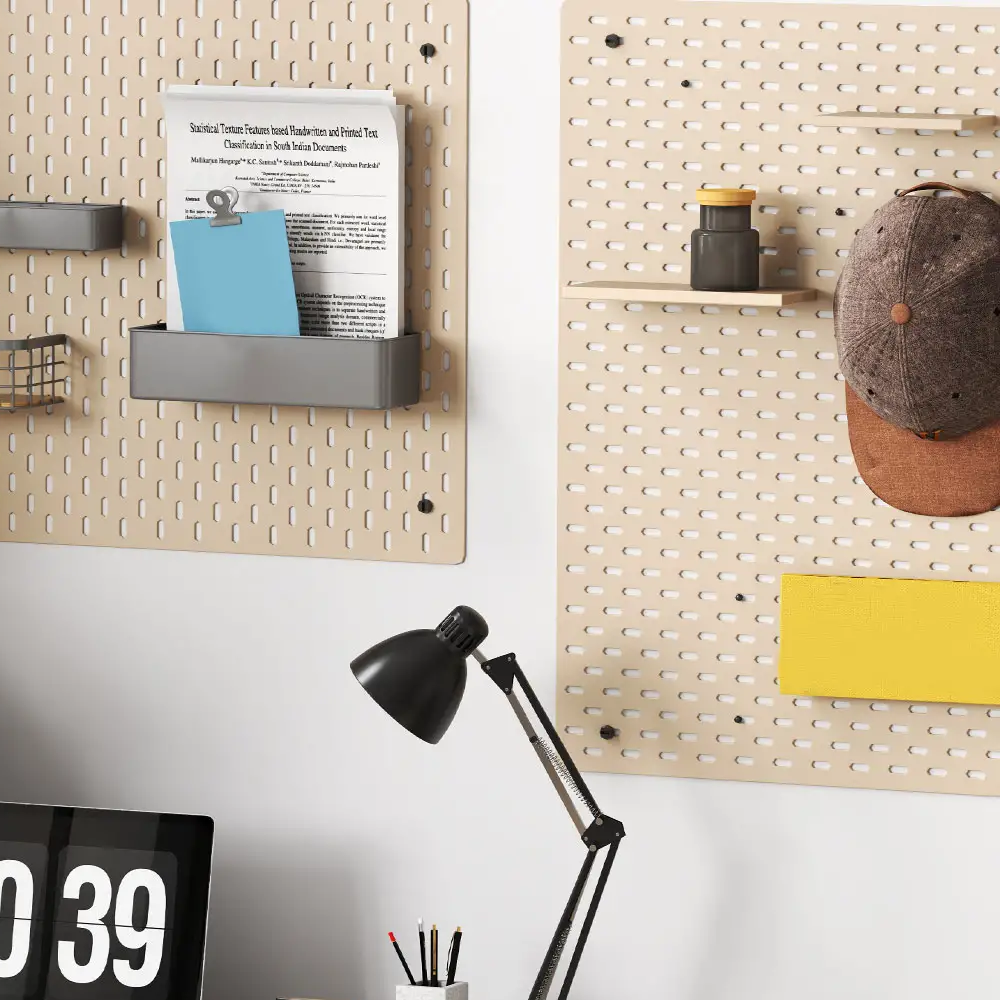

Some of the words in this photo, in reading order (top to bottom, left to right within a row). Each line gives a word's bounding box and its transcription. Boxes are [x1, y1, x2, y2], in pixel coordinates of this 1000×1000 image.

[189, 122, 220, 134] Statistical
[220, 123, 244, 134] Texture
[244, 123, 270, 135] Features
[271, 125, 289, 136] based
[289, 125, 327, 137] Handwritten
[328, 126, 340, 137] and
[340, 126, 363, 138] Printed
[363, 127, 379, 139] Text
[224, 139, 265, 150] Classification
[265, 140, 273, 150] in
[273, 140, 291, 151] South
[292, 141, 312, 151] Indian
[312, 142, 347, 152] Documents
[57, 864, 167, 988] 39
